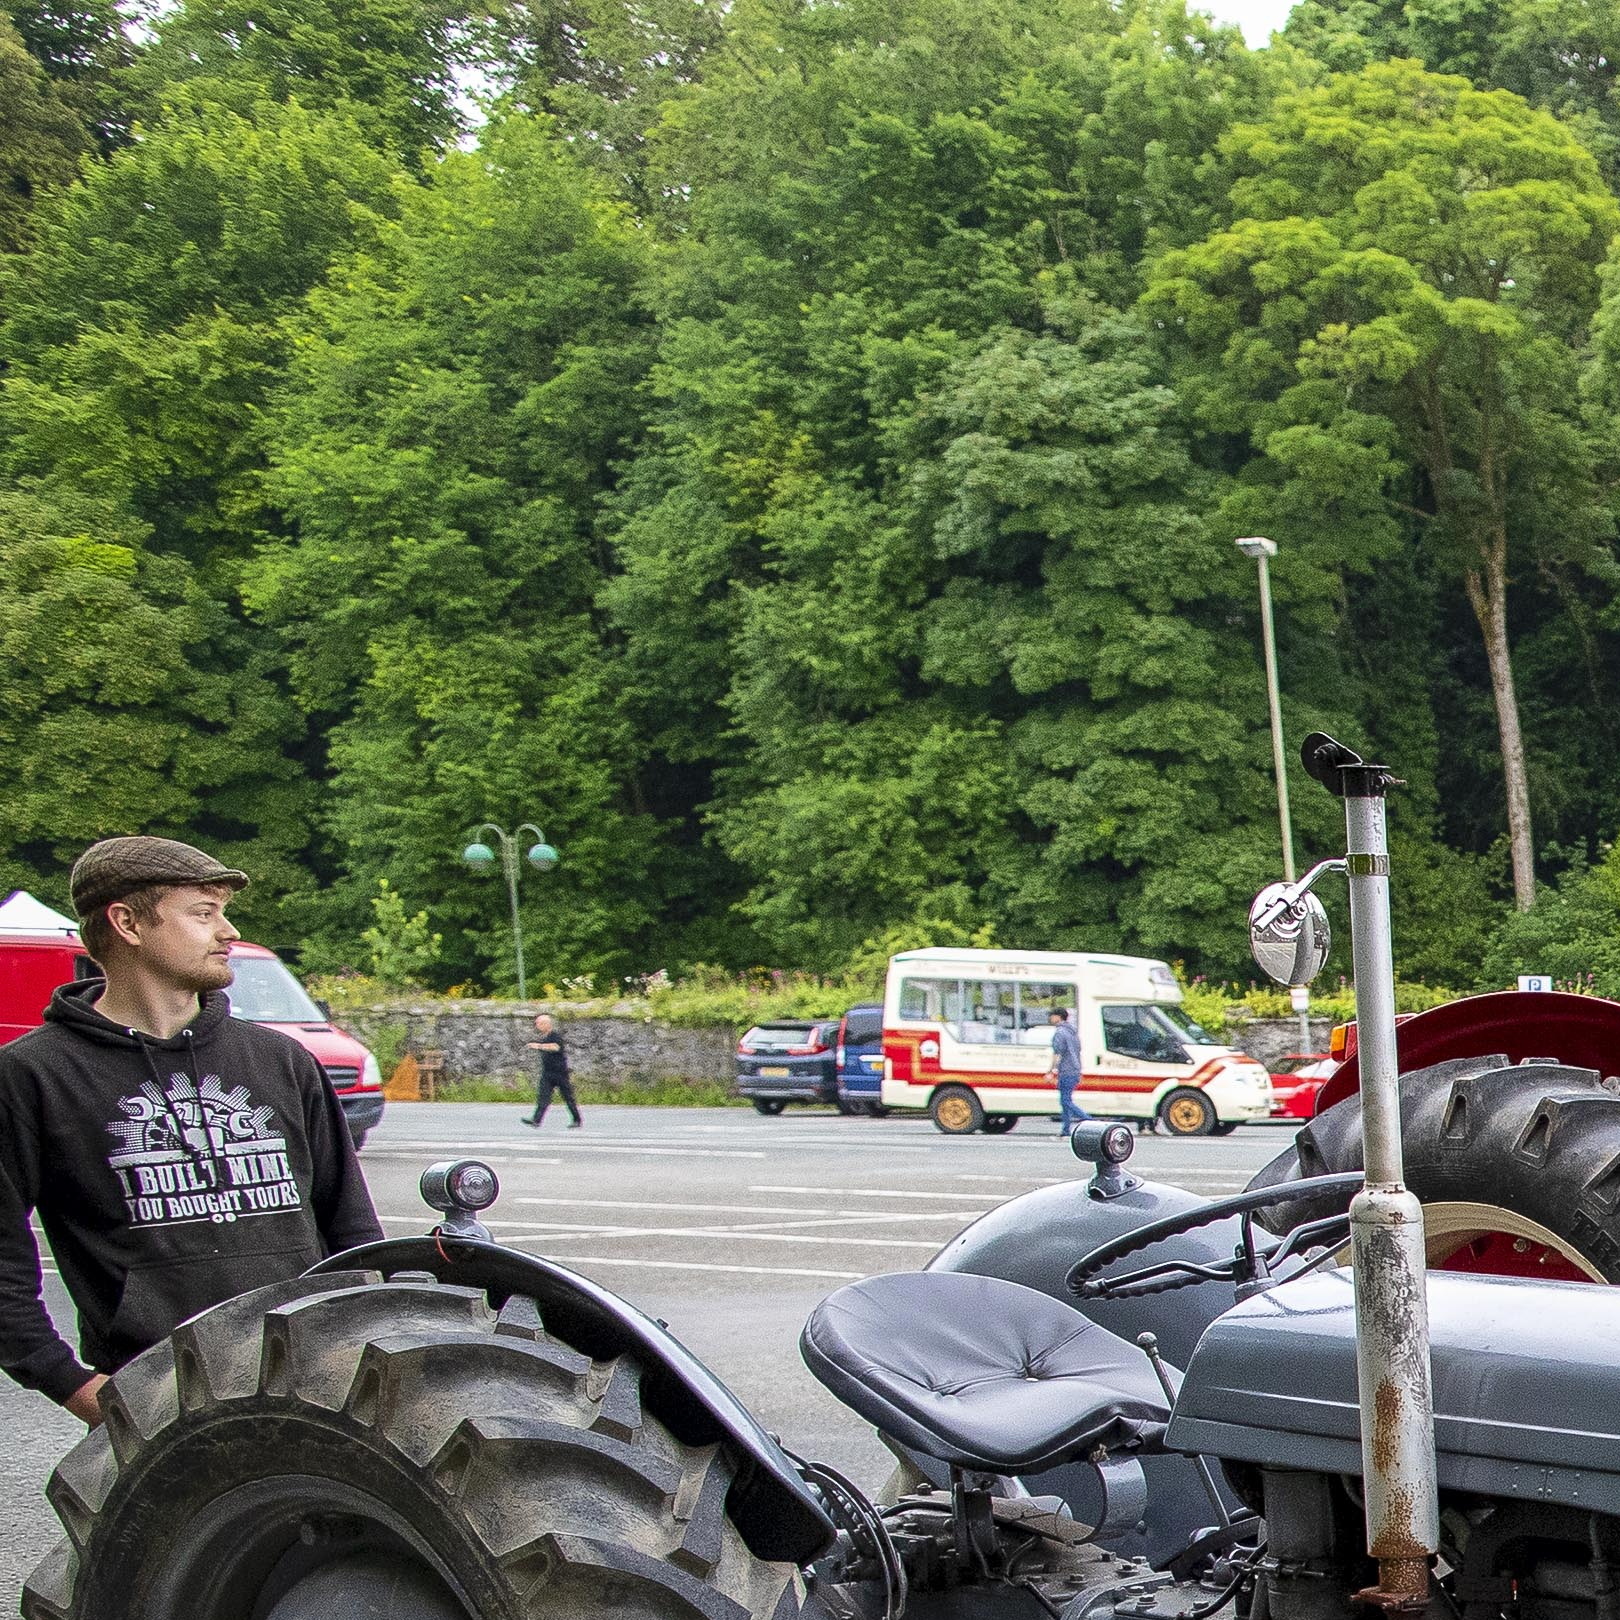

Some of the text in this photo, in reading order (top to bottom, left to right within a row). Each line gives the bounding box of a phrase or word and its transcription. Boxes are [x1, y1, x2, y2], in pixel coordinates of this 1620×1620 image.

[115, 1152, 293, 1197] I BUILT MINE
[125, 1181, 301, 1222] YOU BOUGHT YOURS
